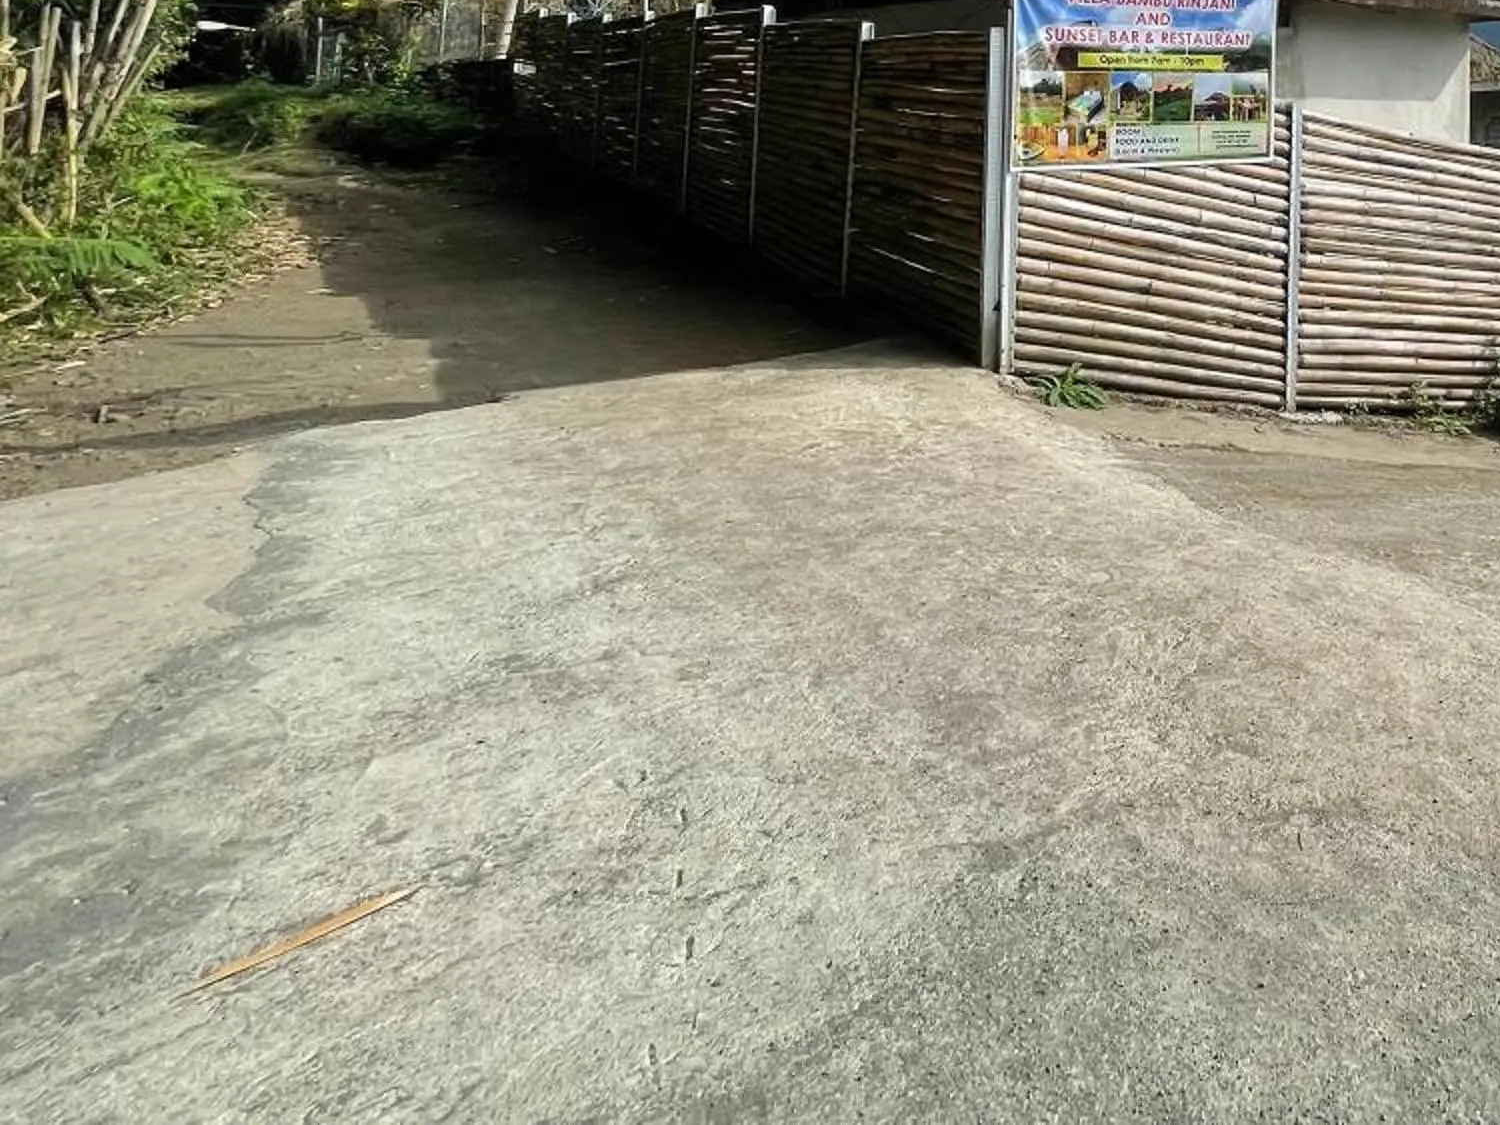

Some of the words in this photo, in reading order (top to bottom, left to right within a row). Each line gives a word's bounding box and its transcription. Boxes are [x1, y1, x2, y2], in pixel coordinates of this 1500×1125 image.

[1135, 12, 1171, 26] AND
[1109, 29, 1139, 44] BAR
[1145, 31, 1155, 44] &
[1161, 31, 1251, 47] RESTAURANT
[1099, 54, 1127, 65] Open
